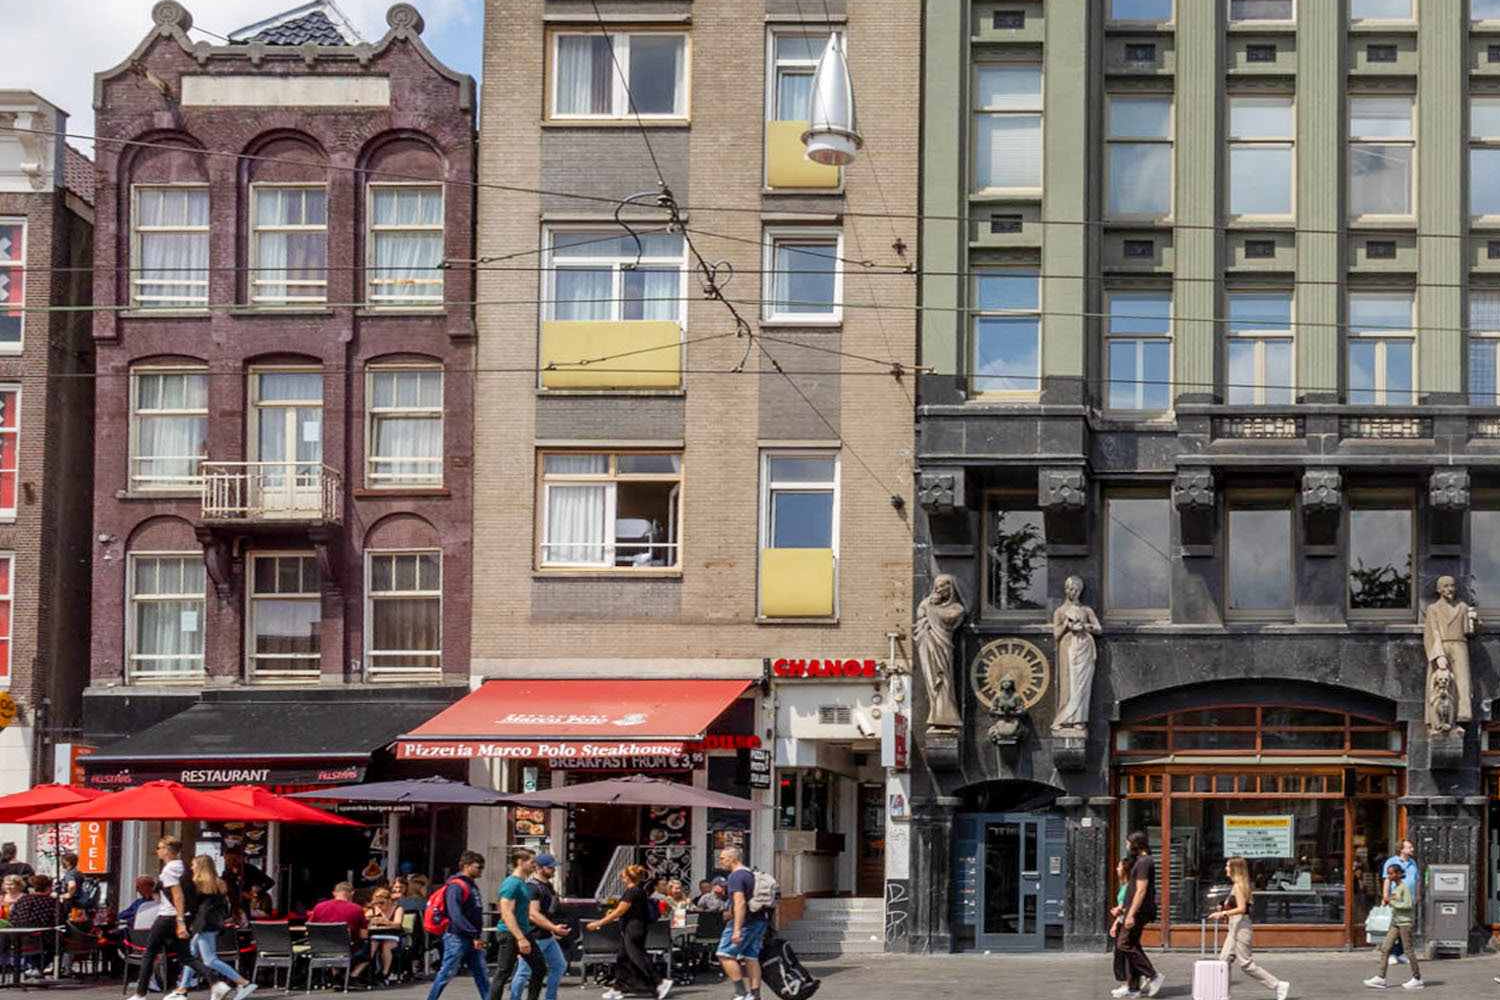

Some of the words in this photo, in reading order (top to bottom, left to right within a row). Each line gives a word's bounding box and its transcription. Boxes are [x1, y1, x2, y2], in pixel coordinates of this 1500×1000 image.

[773, 659, 876, 677] CHANGE
[404, 744, 472, 757] Pizzeria
[477, 744, 531, 757] Marco
[537, 744, 576, 757] Polo
[581, 743, 682, 757] Steakhouse
[549, 756, 627, 769] BREAKFAST
[632, 756, 666, 768] FROM
[181, 769, 270, 783] RESTAURANT
[88, 822, 100, 871] OTEL
